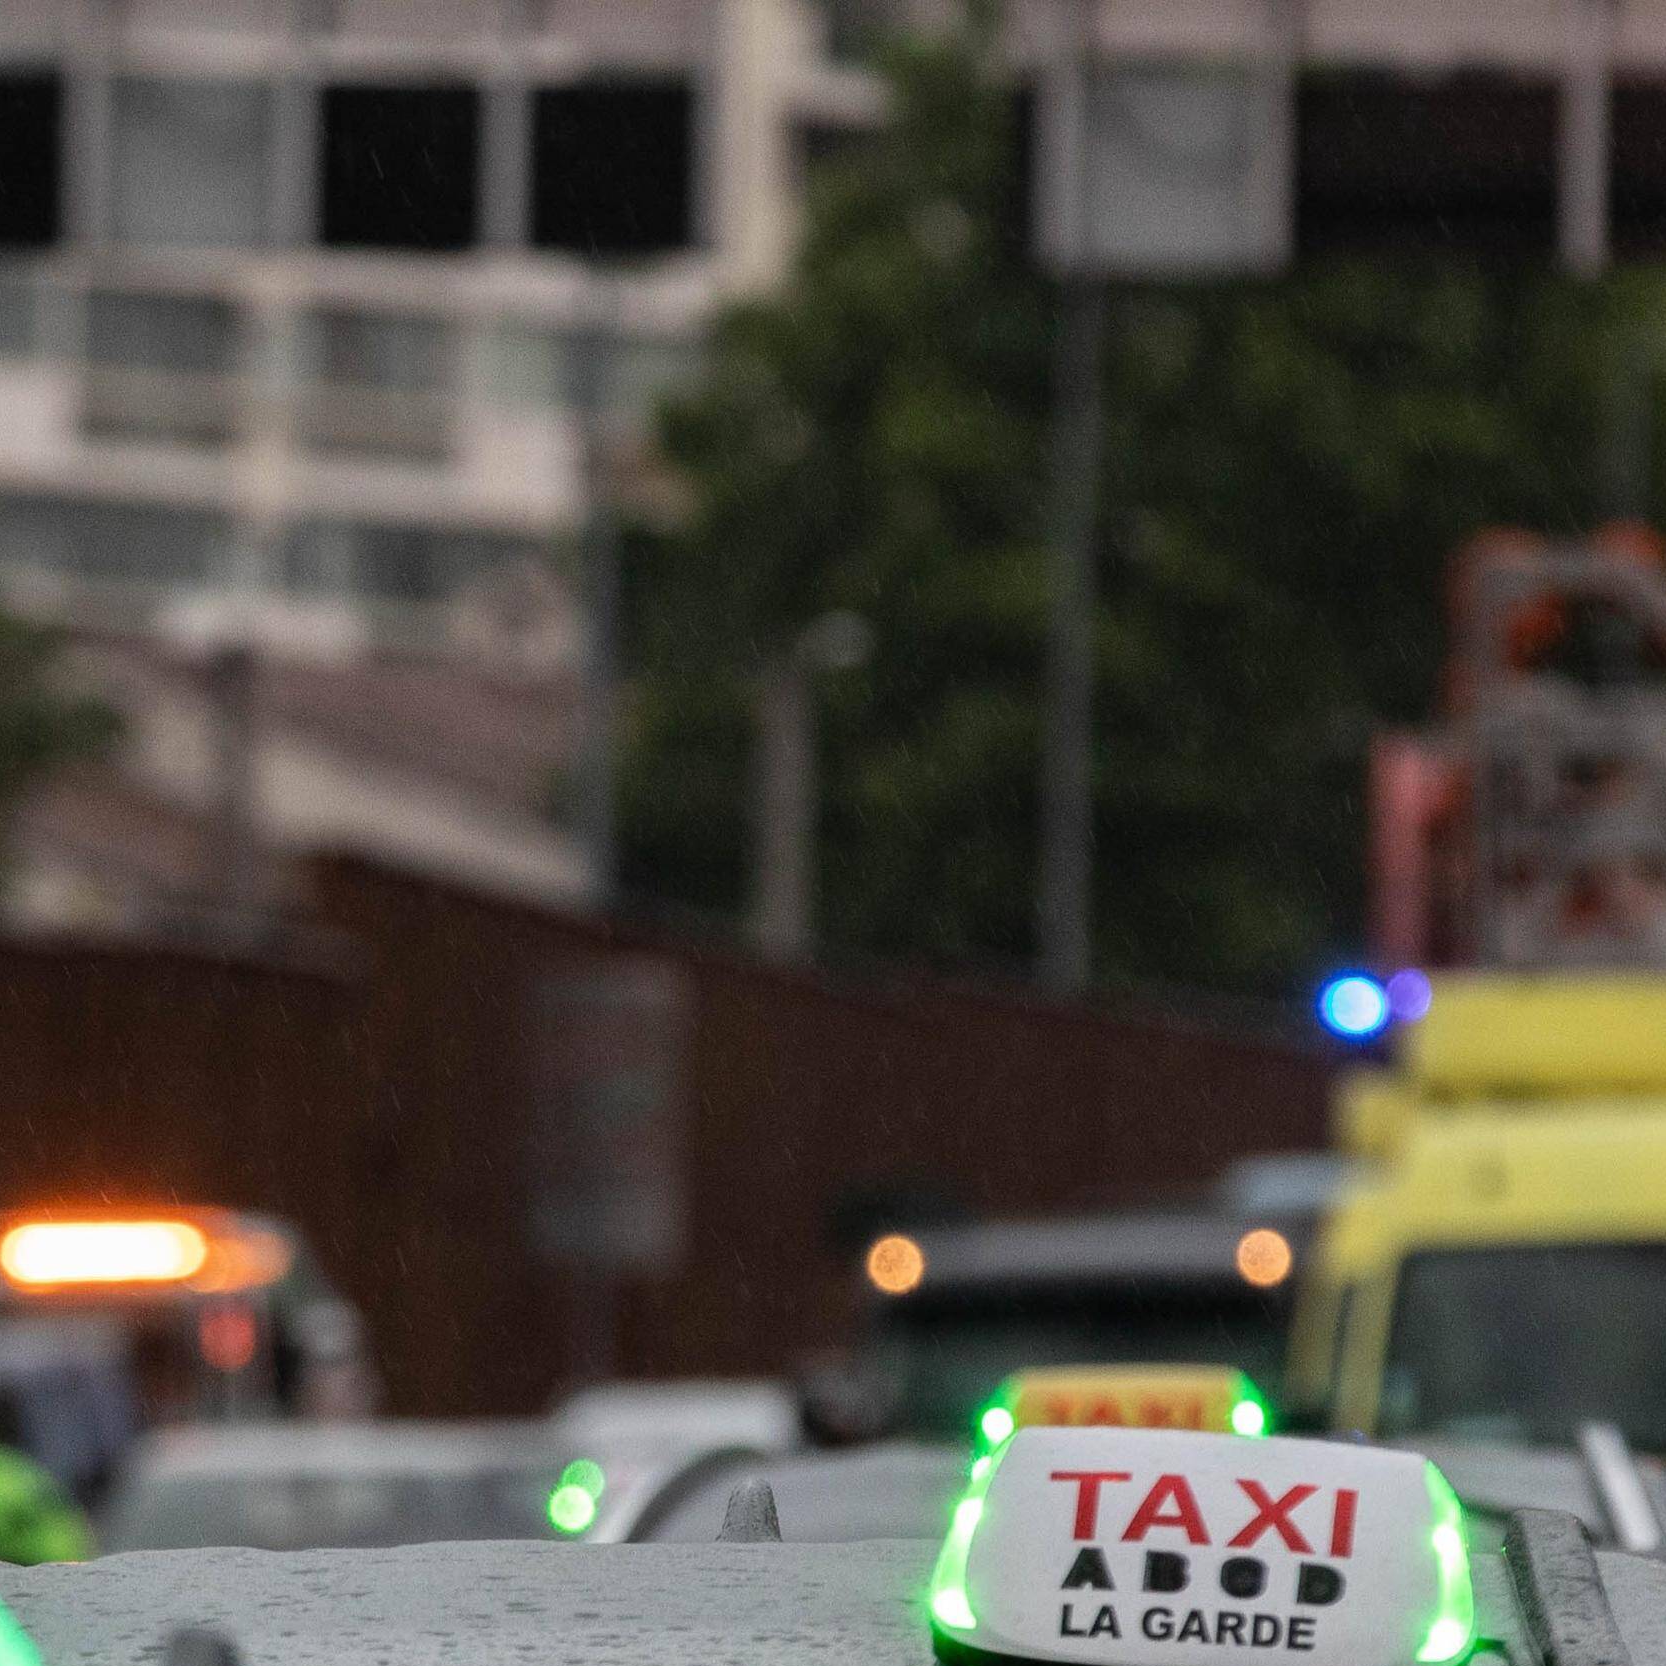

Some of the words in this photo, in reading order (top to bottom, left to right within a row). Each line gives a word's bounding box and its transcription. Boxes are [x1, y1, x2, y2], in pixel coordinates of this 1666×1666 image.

[1048, 1470, 1360, 1559] TAXI
[1060, 1603, 1122, 1639] LA
[1141, 1606, 1318, 1651] GARDE
